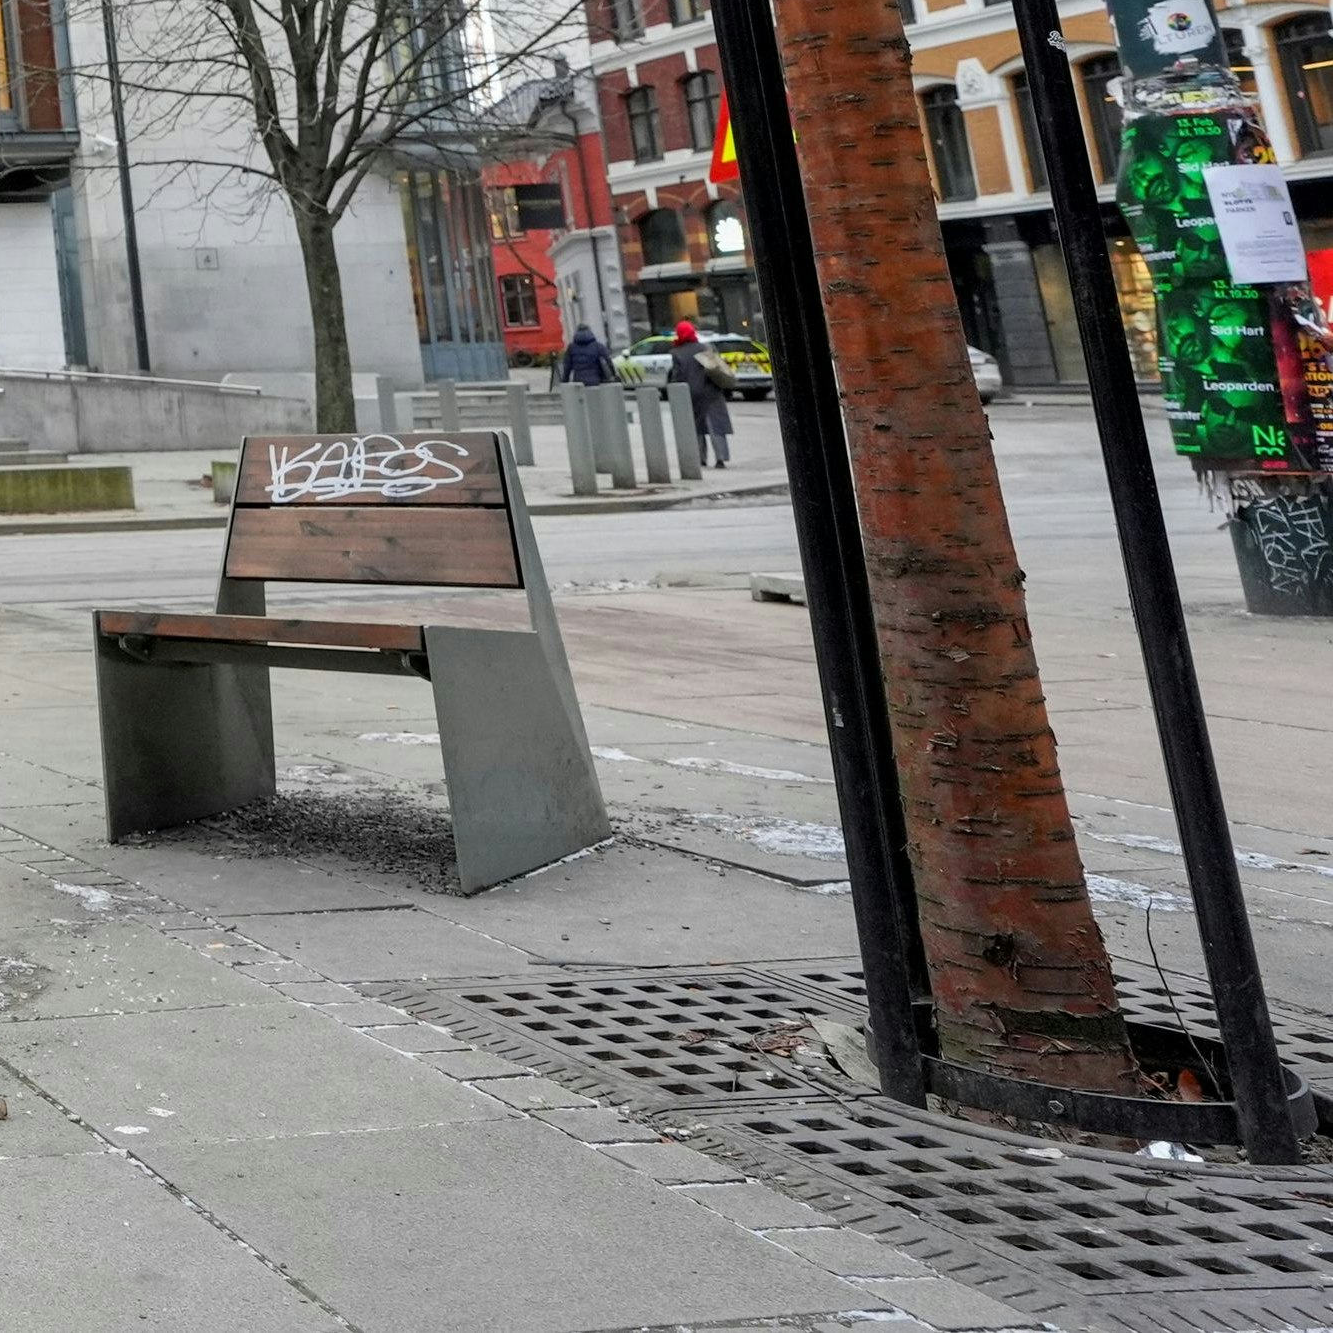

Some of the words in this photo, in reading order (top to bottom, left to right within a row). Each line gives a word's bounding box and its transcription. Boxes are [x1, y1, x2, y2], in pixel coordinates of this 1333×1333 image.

[1175, 217, 1215, 229] Leopa
[1236, 325, 1265, 337] Hart
[1202, 381, 1275, 393] Leoparden
